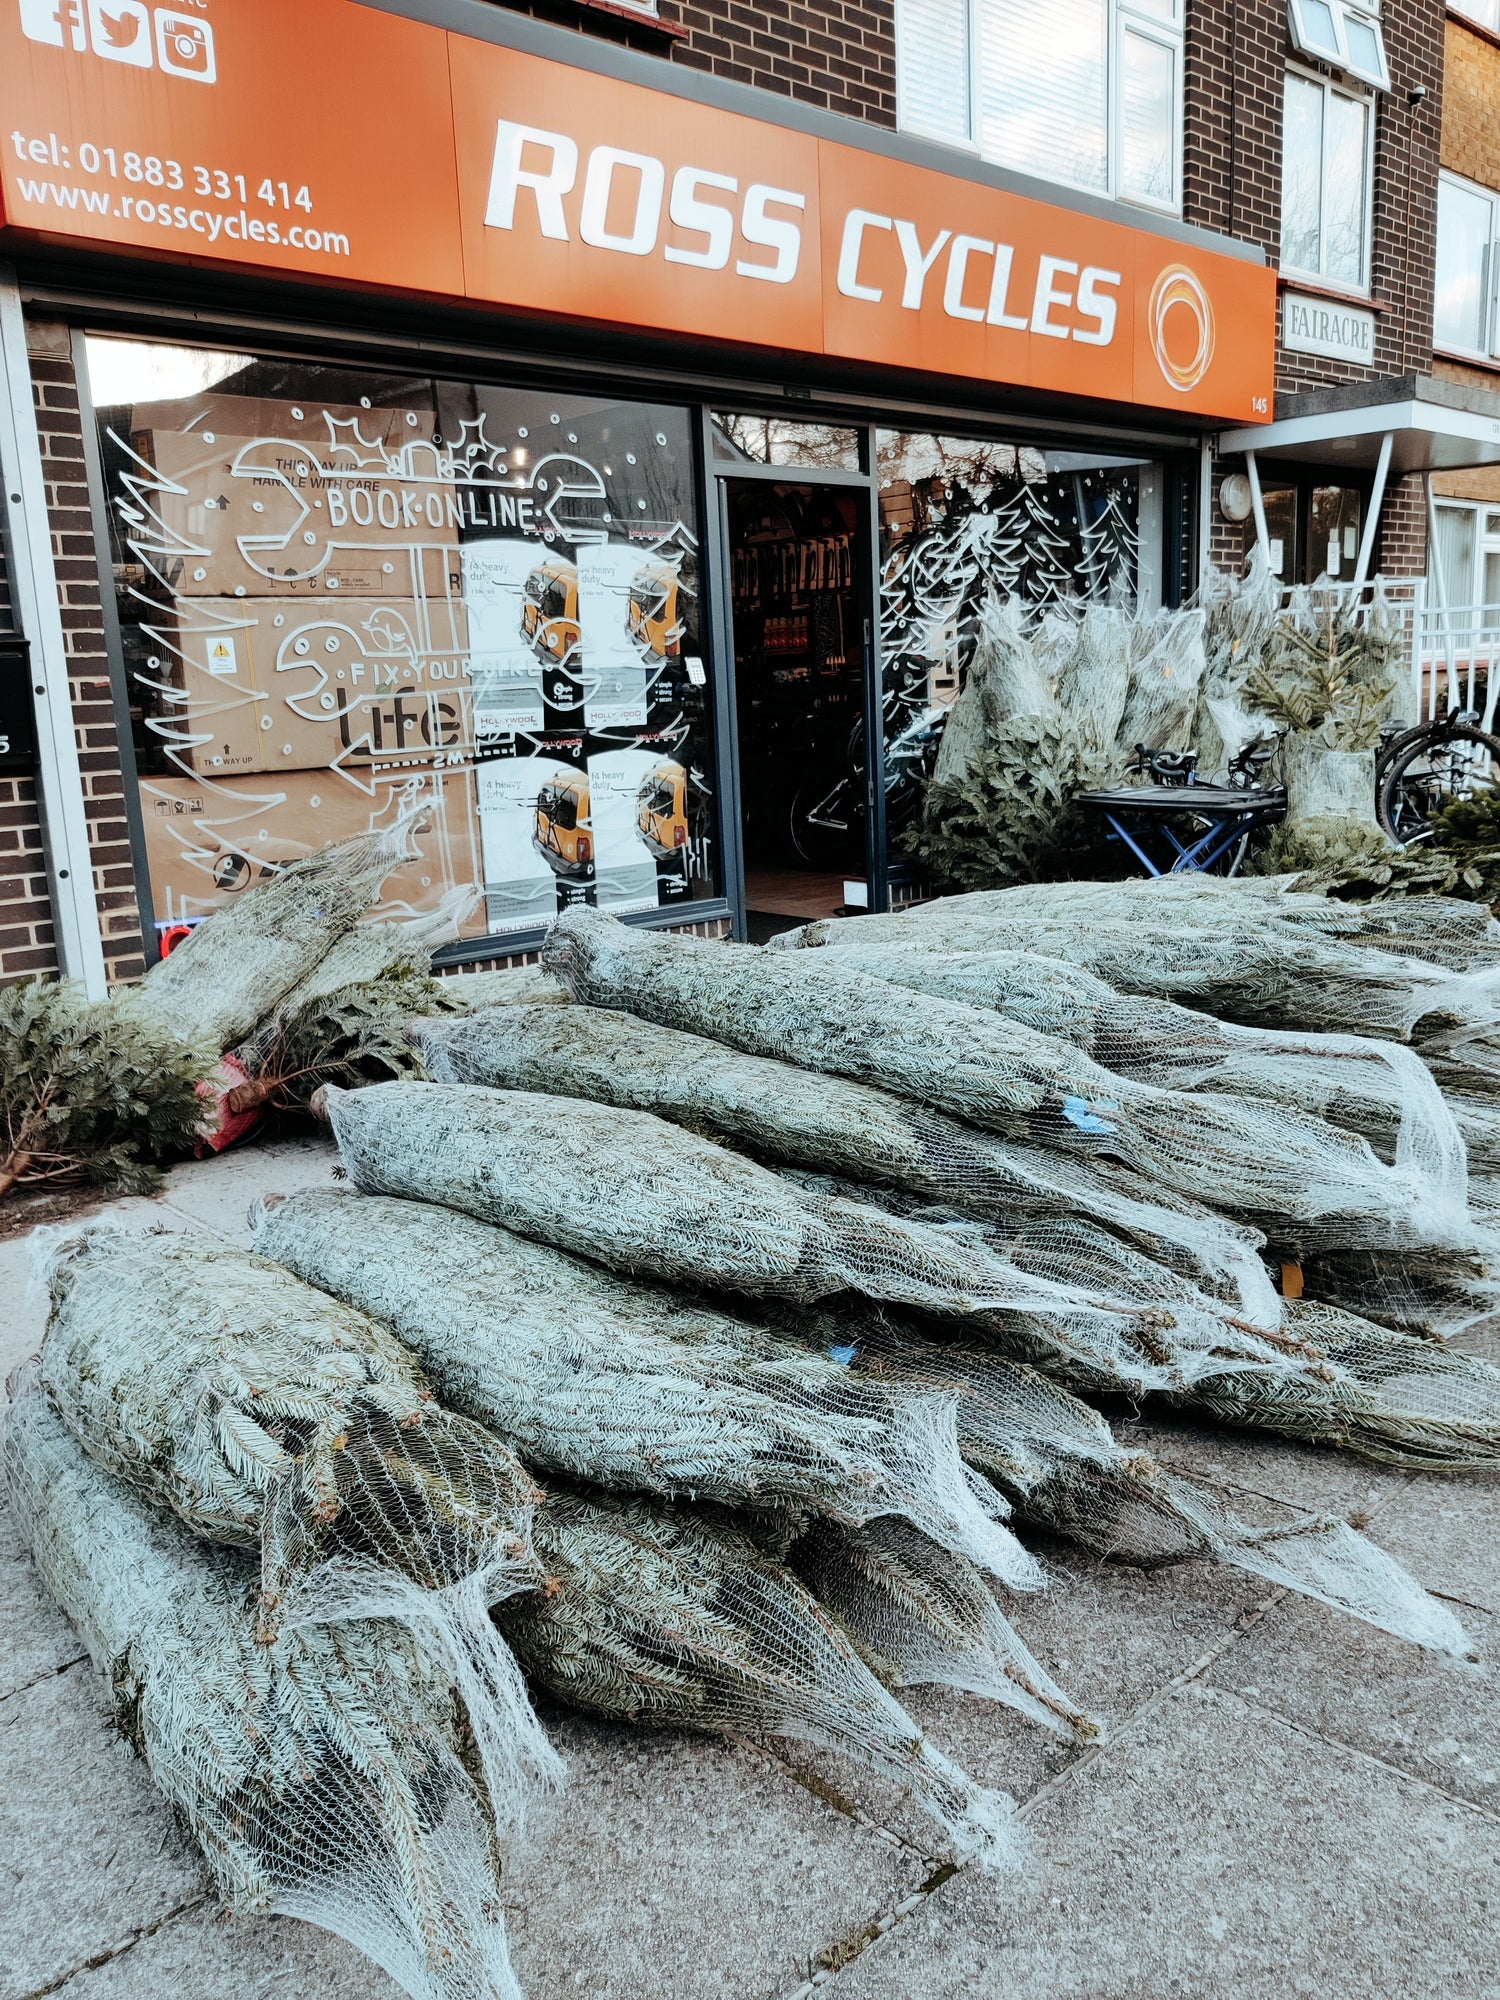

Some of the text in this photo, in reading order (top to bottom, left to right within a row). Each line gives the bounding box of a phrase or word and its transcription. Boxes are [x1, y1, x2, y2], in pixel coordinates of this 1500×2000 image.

[11, 130, 313, 213] tel: 01883 331 414
[16, 177, 350, 256] www.rosscycles.com
[484, 118, 1121, 346] ROSS CYCLES
[1290, 304, 1369, 350] FAIRACRE
[1251, 396, 1268, 414] 145
[310, 478, 342, 490] WITH
[346, 480, 380, 492] CARE
[327, 487, 536, 530] BOOK ONLINE
[350, 657, 541, 685] FIX YOUR BIKE
[222, 757, 240, 766] WAY
[242, 757, 253, 765] UP
[602, 771, 625, 781] heavy
